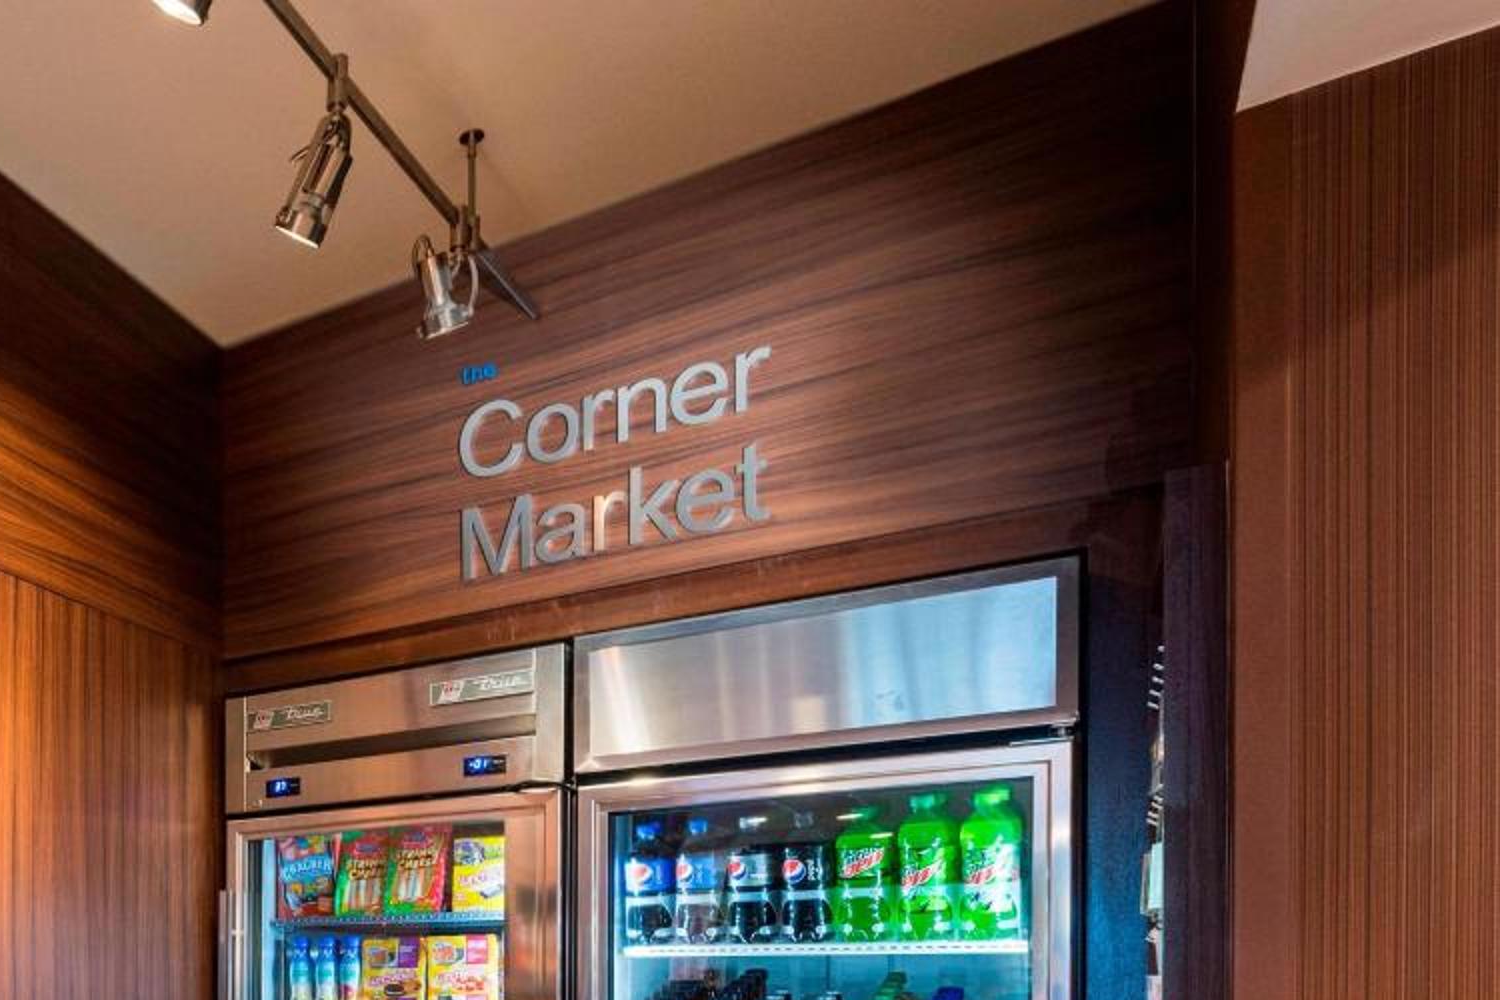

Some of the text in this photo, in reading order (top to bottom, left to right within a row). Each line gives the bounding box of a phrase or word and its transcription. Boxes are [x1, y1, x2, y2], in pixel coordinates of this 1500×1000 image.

[459, 345, 772, 478] Corner
[461, 362, 497, 385] the
[460, 443, 772, 581] Market
